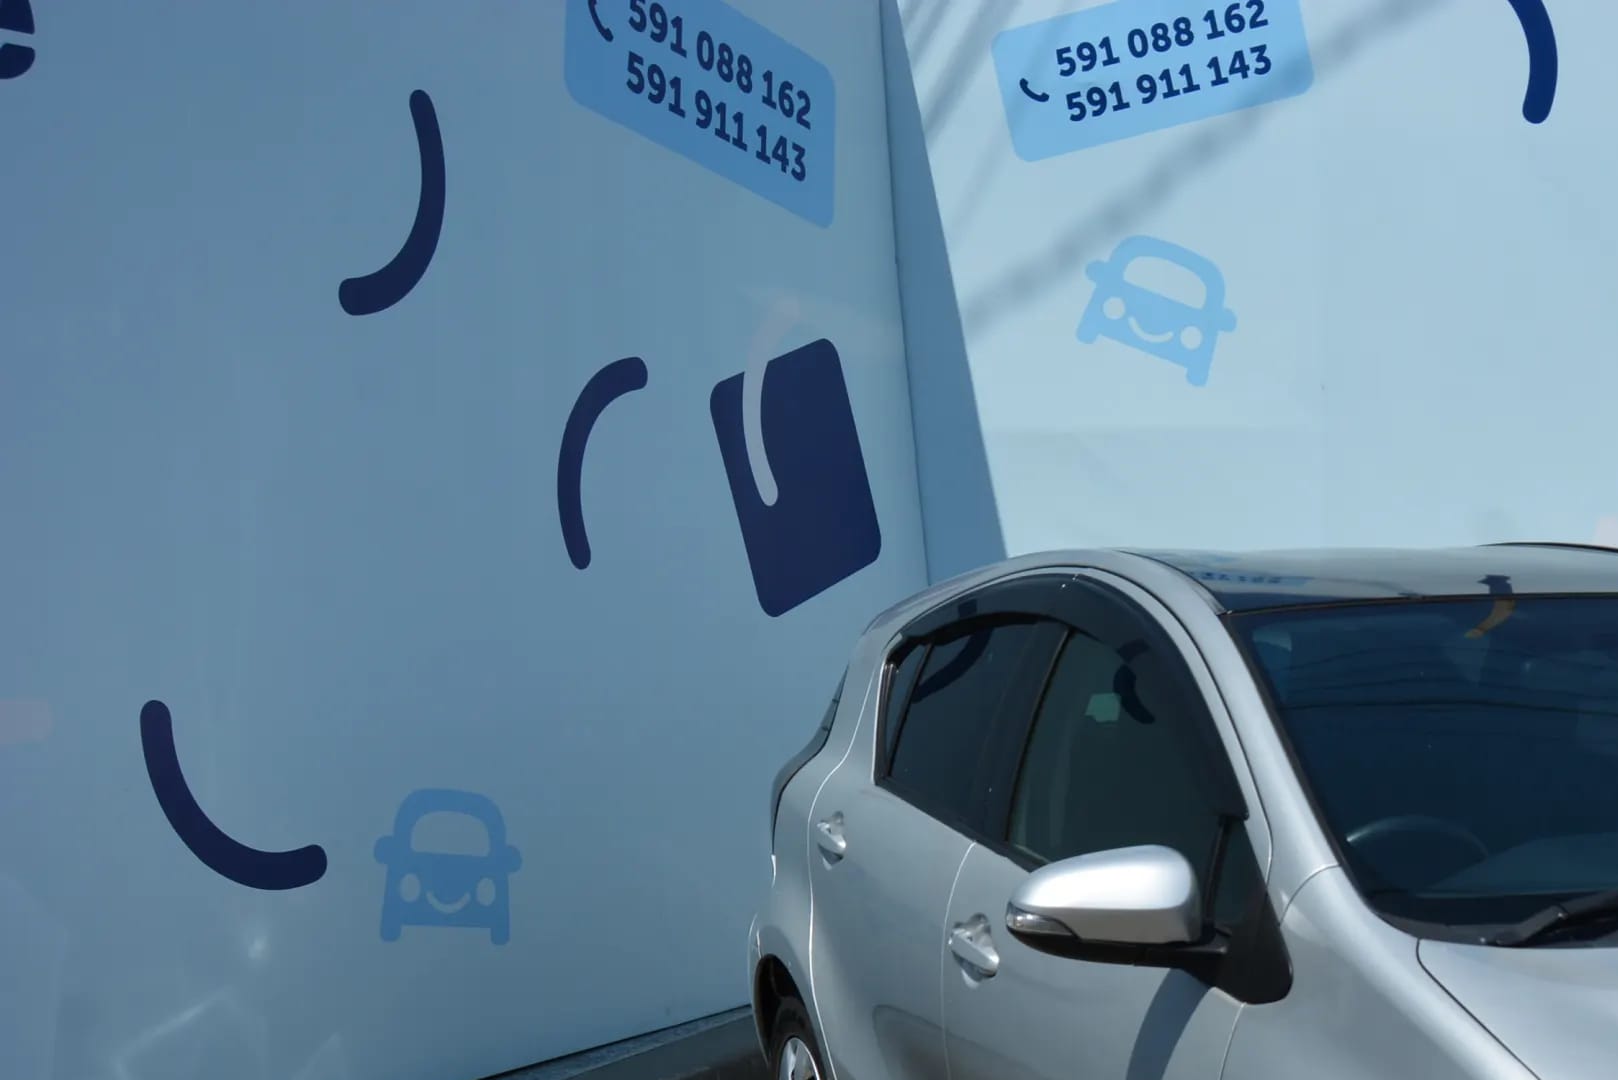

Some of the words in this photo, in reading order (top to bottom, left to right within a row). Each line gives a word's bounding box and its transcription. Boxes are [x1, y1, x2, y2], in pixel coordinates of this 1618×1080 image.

[629, 0, 688, 58] 591
[696, 30, 753, 94] 088
[762, 69, 811, 130] 162
[1055, 36, 1120, 77] 591
[1127, 16, 1194, 58] 088
[1203, 0, 1269, 40] 162
[1066, 81, 1130, 122] 591
[1136, 63, 1200, 104] 911
[1207, 44, 1272, 86] 143
[626, 51, 686, 118] 591
[695, 89, 748, 152] 911
[756, 124, 806, 182] 143
